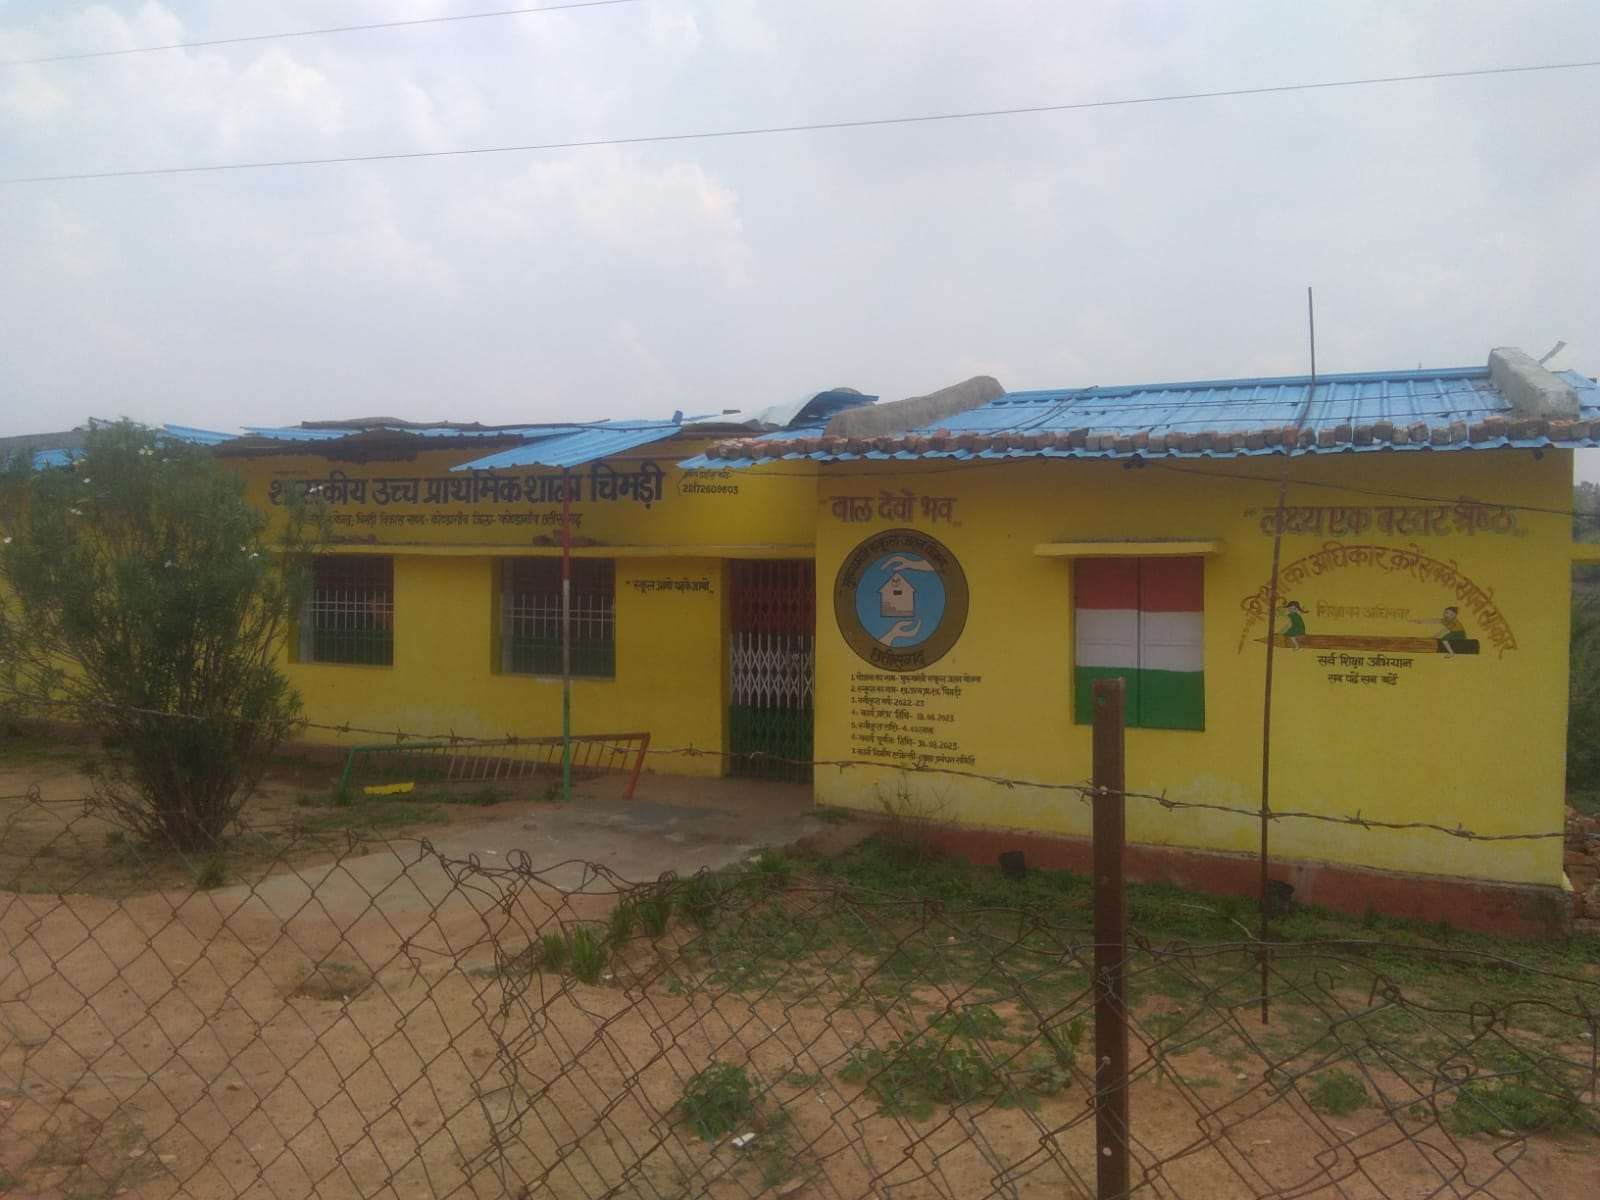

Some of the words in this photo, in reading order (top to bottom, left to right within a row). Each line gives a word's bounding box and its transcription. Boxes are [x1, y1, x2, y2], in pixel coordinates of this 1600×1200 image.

[372, 477, 421, 505] उच्च
[422, 468, 521, 504] प्राथमिक
[588, 461, 665, 510] चिमड़ी
[1326, 506, 1372, 536] एक
[1317, 652, 1338, 667] सर्व
[1368, 654, 1415, 668] अभियान
